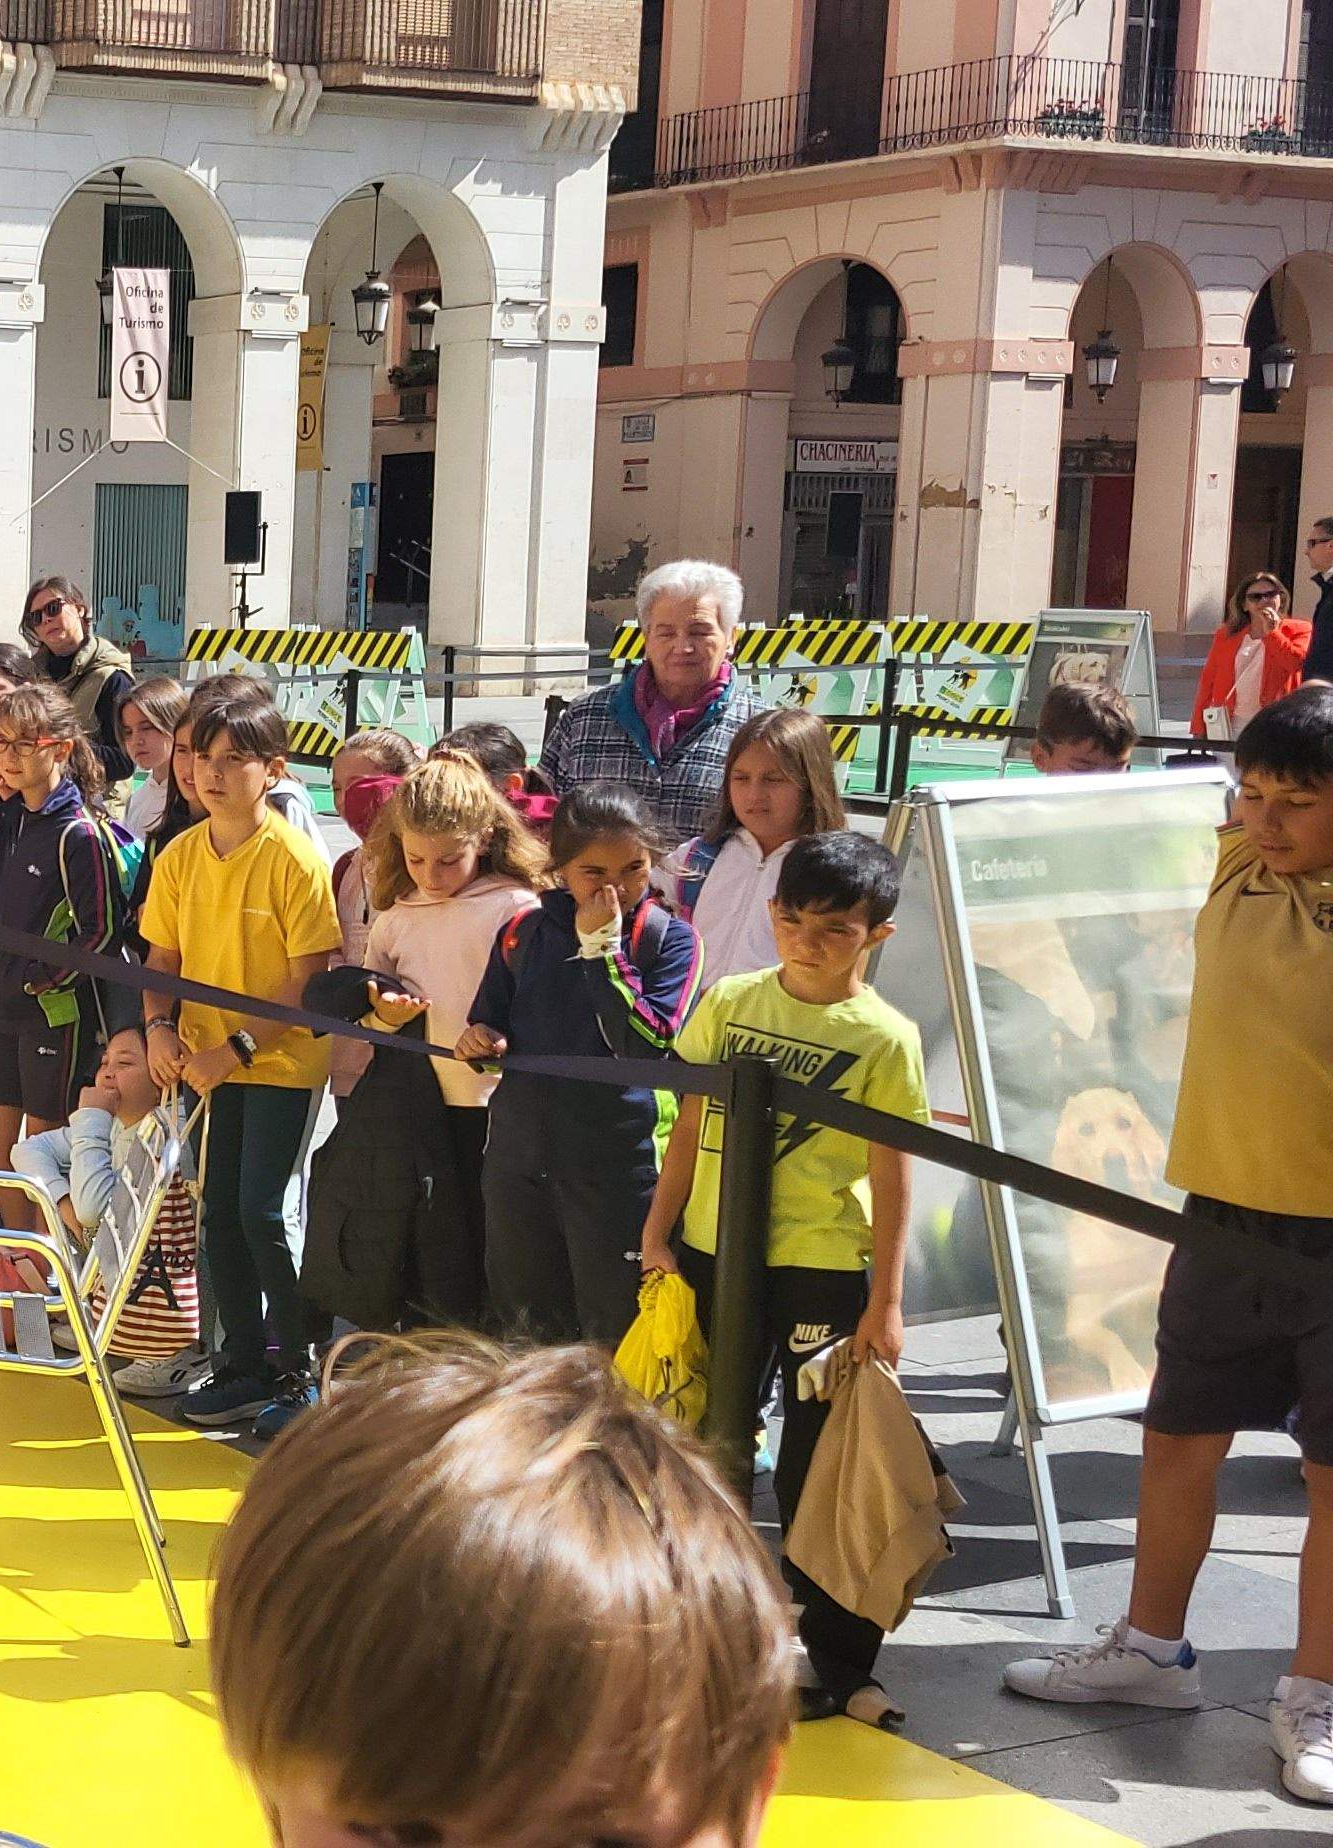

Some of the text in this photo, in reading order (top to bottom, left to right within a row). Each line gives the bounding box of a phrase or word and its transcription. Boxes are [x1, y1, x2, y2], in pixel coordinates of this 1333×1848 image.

[125, 286, 164, 299] Oficina
[149, 302, 164, 314] de
[119, 317, 164, 330] Turismo
[800, 442, 876, 462] CHACINERIA
[726, 1032, 824, 1076] WALKING
[795, 1323, 831, 1342] NIKE
